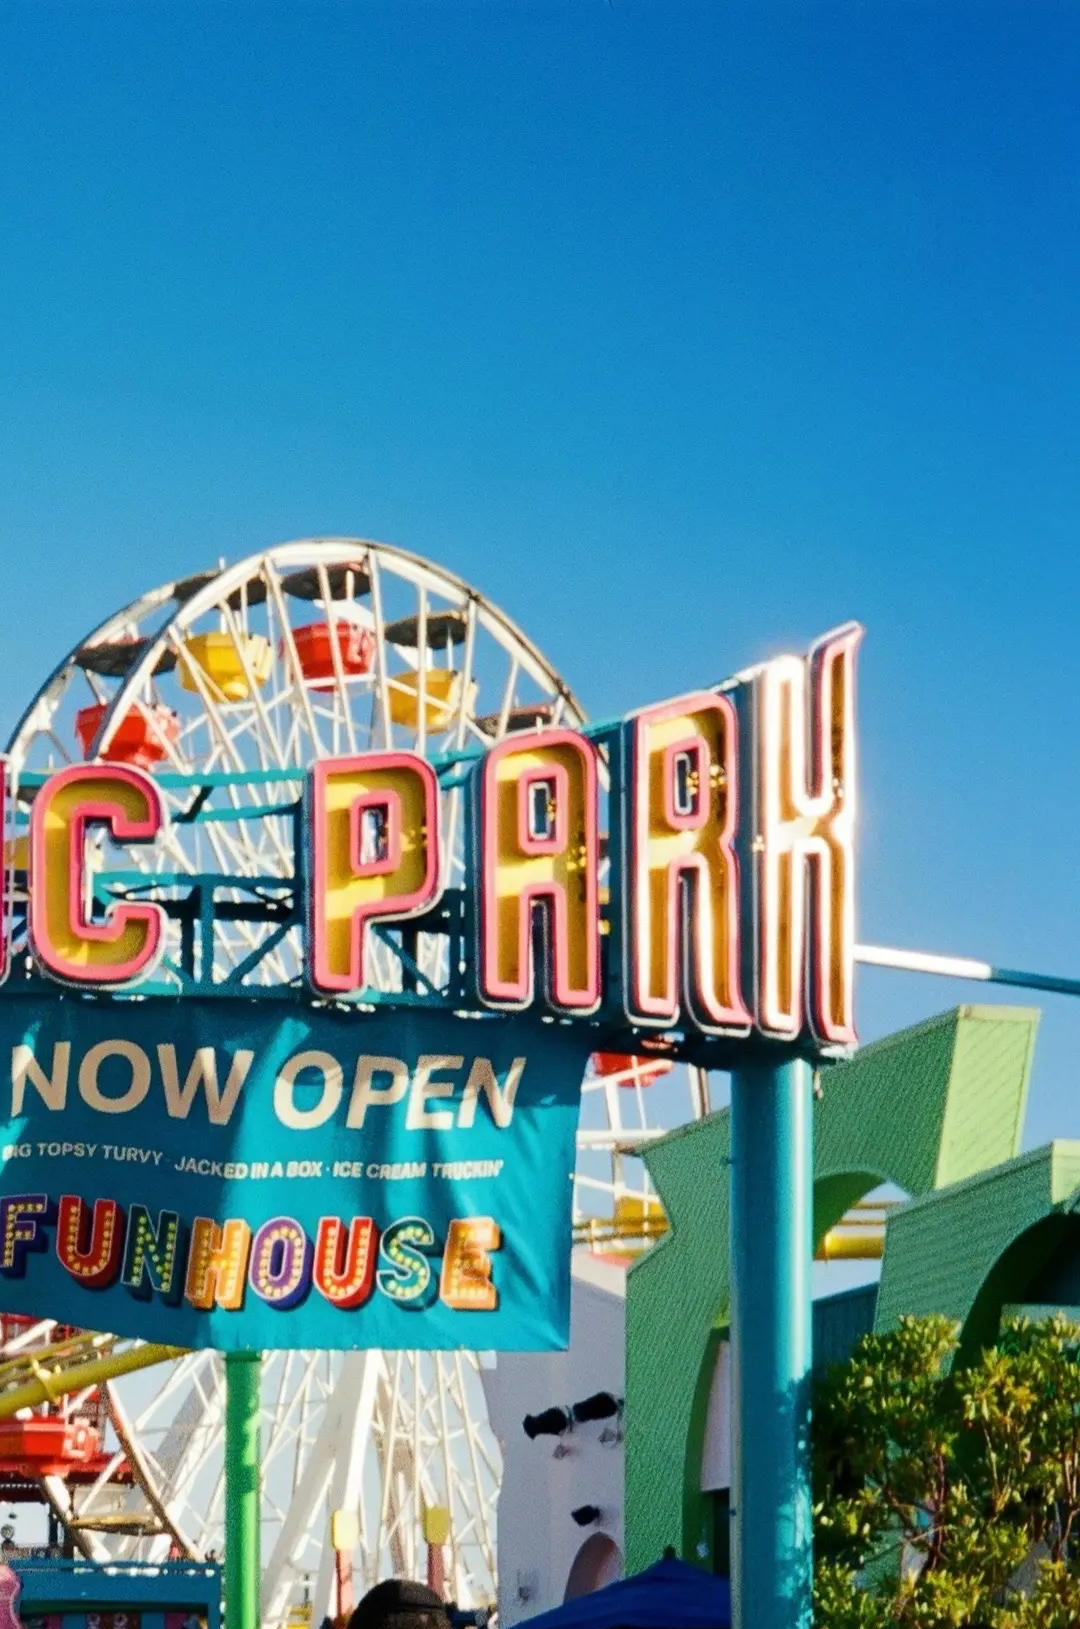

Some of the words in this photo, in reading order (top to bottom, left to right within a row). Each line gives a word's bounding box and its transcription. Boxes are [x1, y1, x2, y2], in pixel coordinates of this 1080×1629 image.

[305, 621, 864, 1043] PARK
[9, 1039, 256, 1126] NOW
[272, 1049, 528, 1130] OPEN
[36, 1143, 99, 1158] TOPSY
[102, 1144, 163, 1166] TURVY
[174, 1156, 249, 1180] JACKED
[250, 1162, 269, 1179] IN
[270, 1161, 284, 1178] A
[286, 1161, 323, 1178] BOX
[332, 1161, 364, 1178] ICE
[366, 1161, 427, 1180] CREAM
